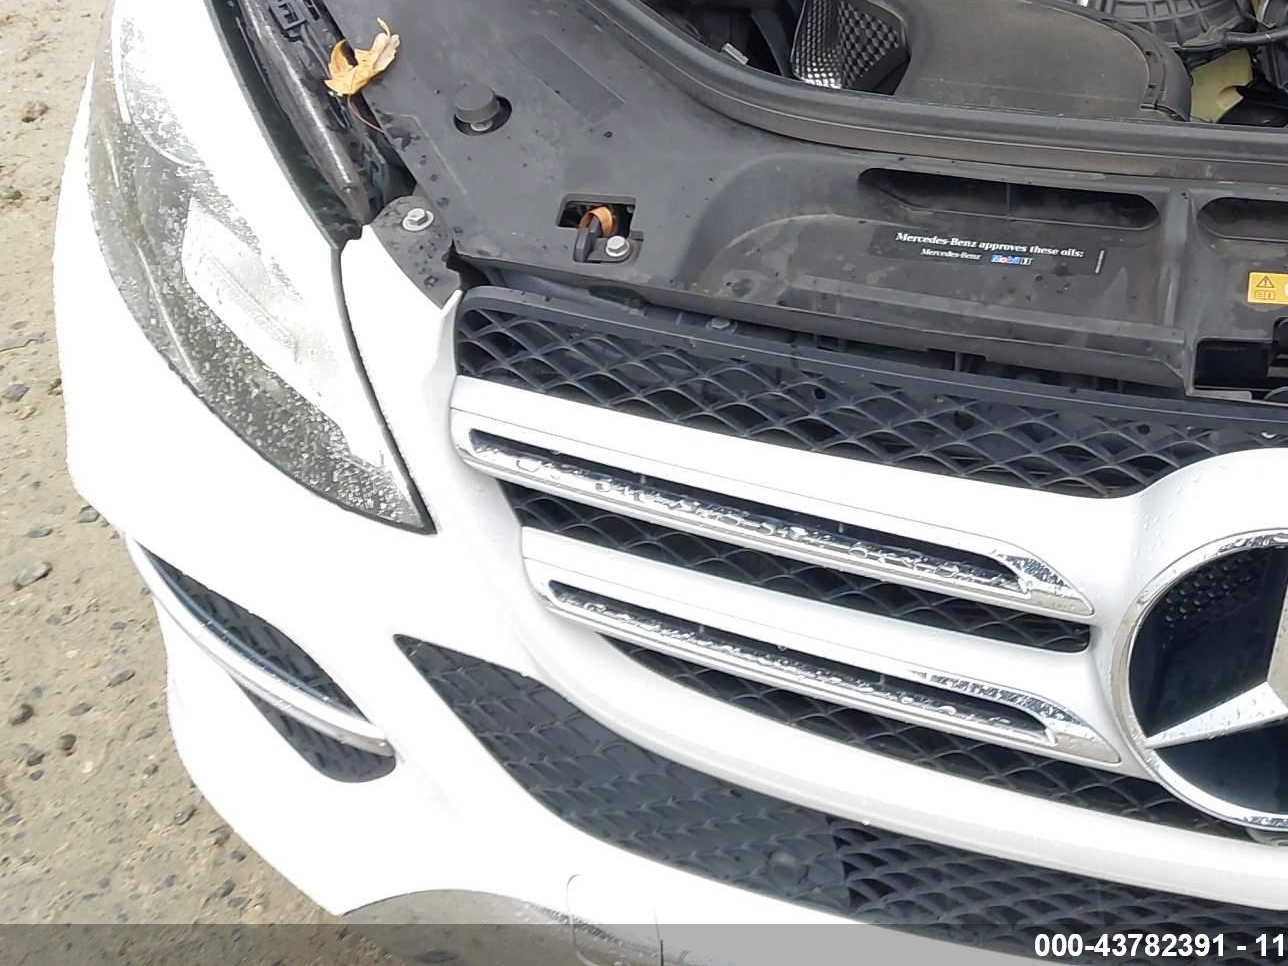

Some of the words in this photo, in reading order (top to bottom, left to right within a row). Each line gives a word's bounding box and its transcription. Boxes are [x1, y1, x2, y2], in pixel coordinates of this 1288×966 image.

[895, 232, 978, 248] Mercedes-Benz
[978, 241, 1028, 253] approves
[1029, 245, 1060, 255] these
[1060, 248, 1085, 258] oils:
[920, 248, 982, 260] Mercedes-Benz
